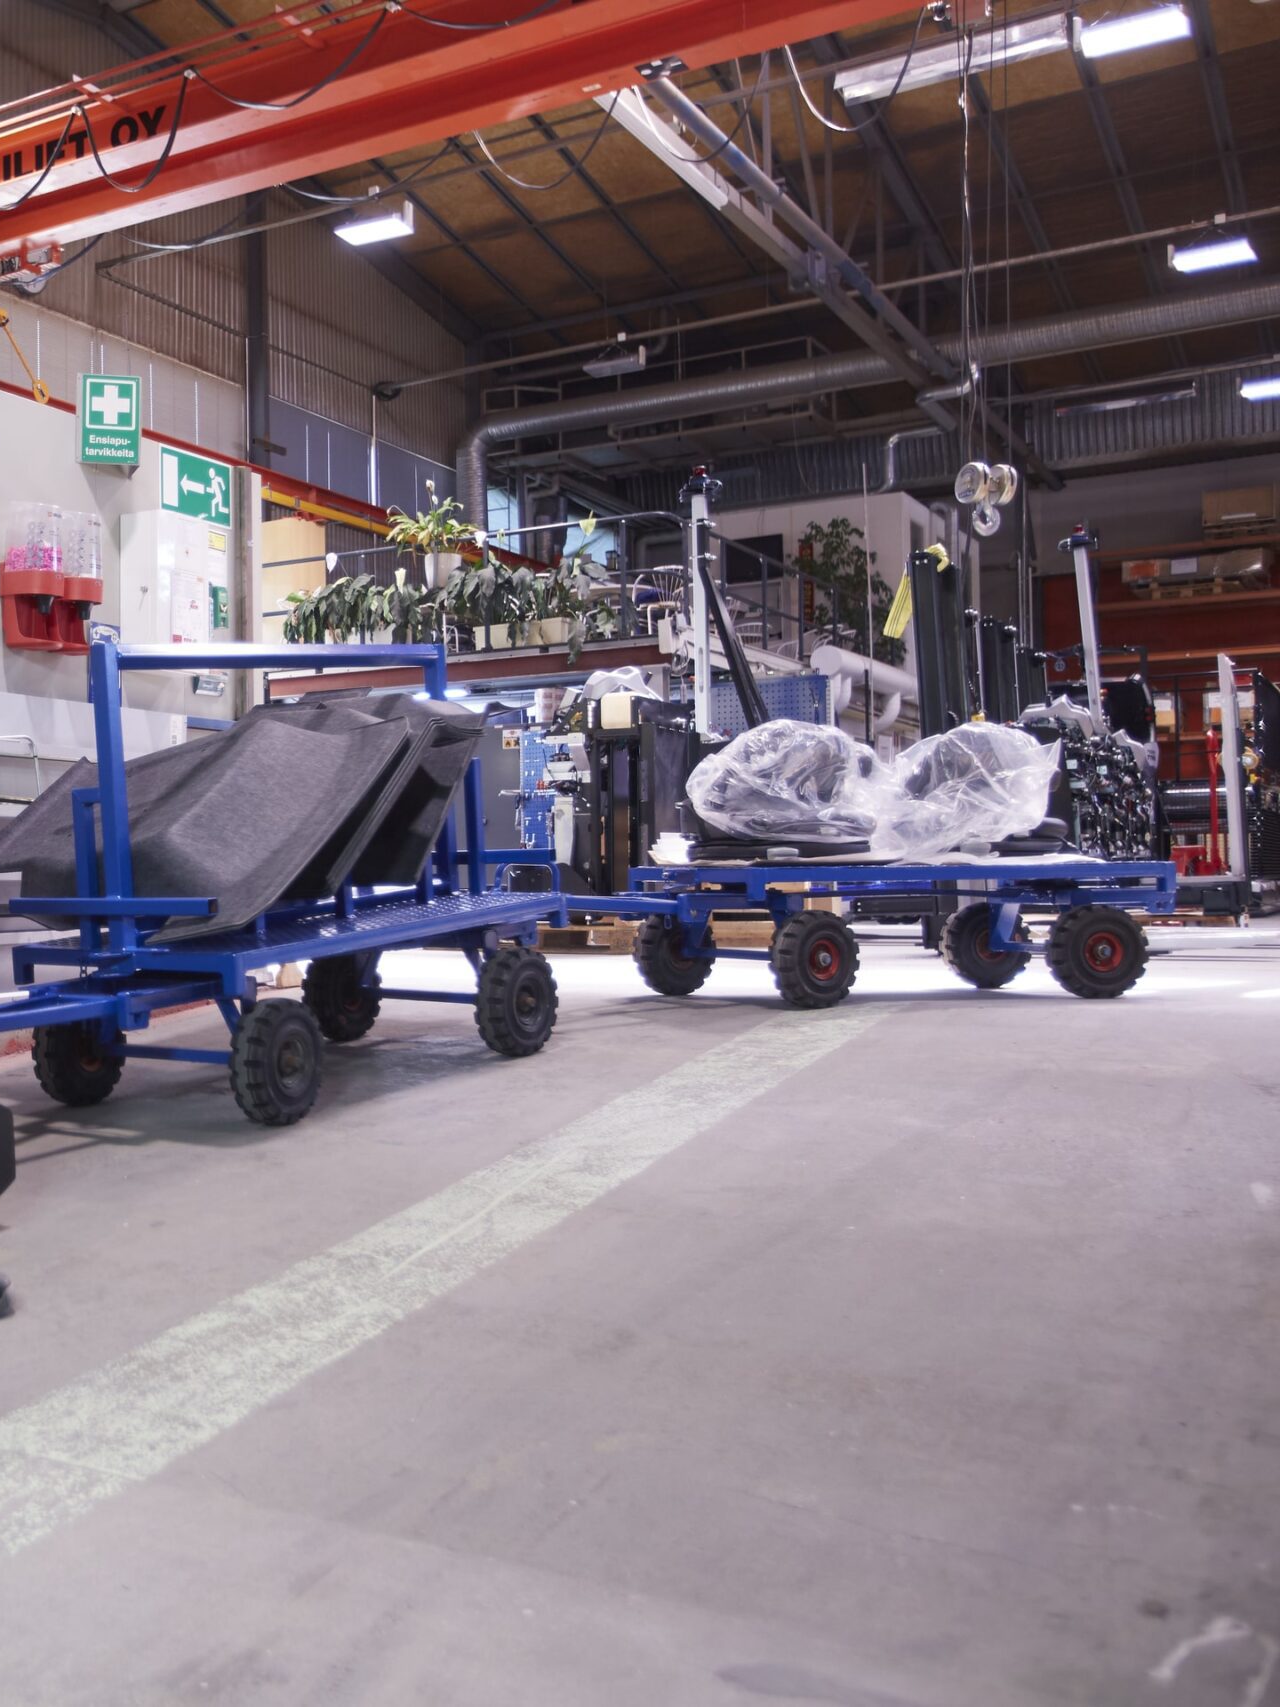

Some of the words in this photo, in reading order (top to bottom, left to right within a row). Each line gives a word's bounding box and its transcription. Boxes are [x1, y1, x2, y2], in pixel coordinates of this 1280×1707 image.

[111, 106, 166, 148] OY
[89, 434, 132, 447] Ensiapu-
[85, 446, 135, 458] tarvikkeita
